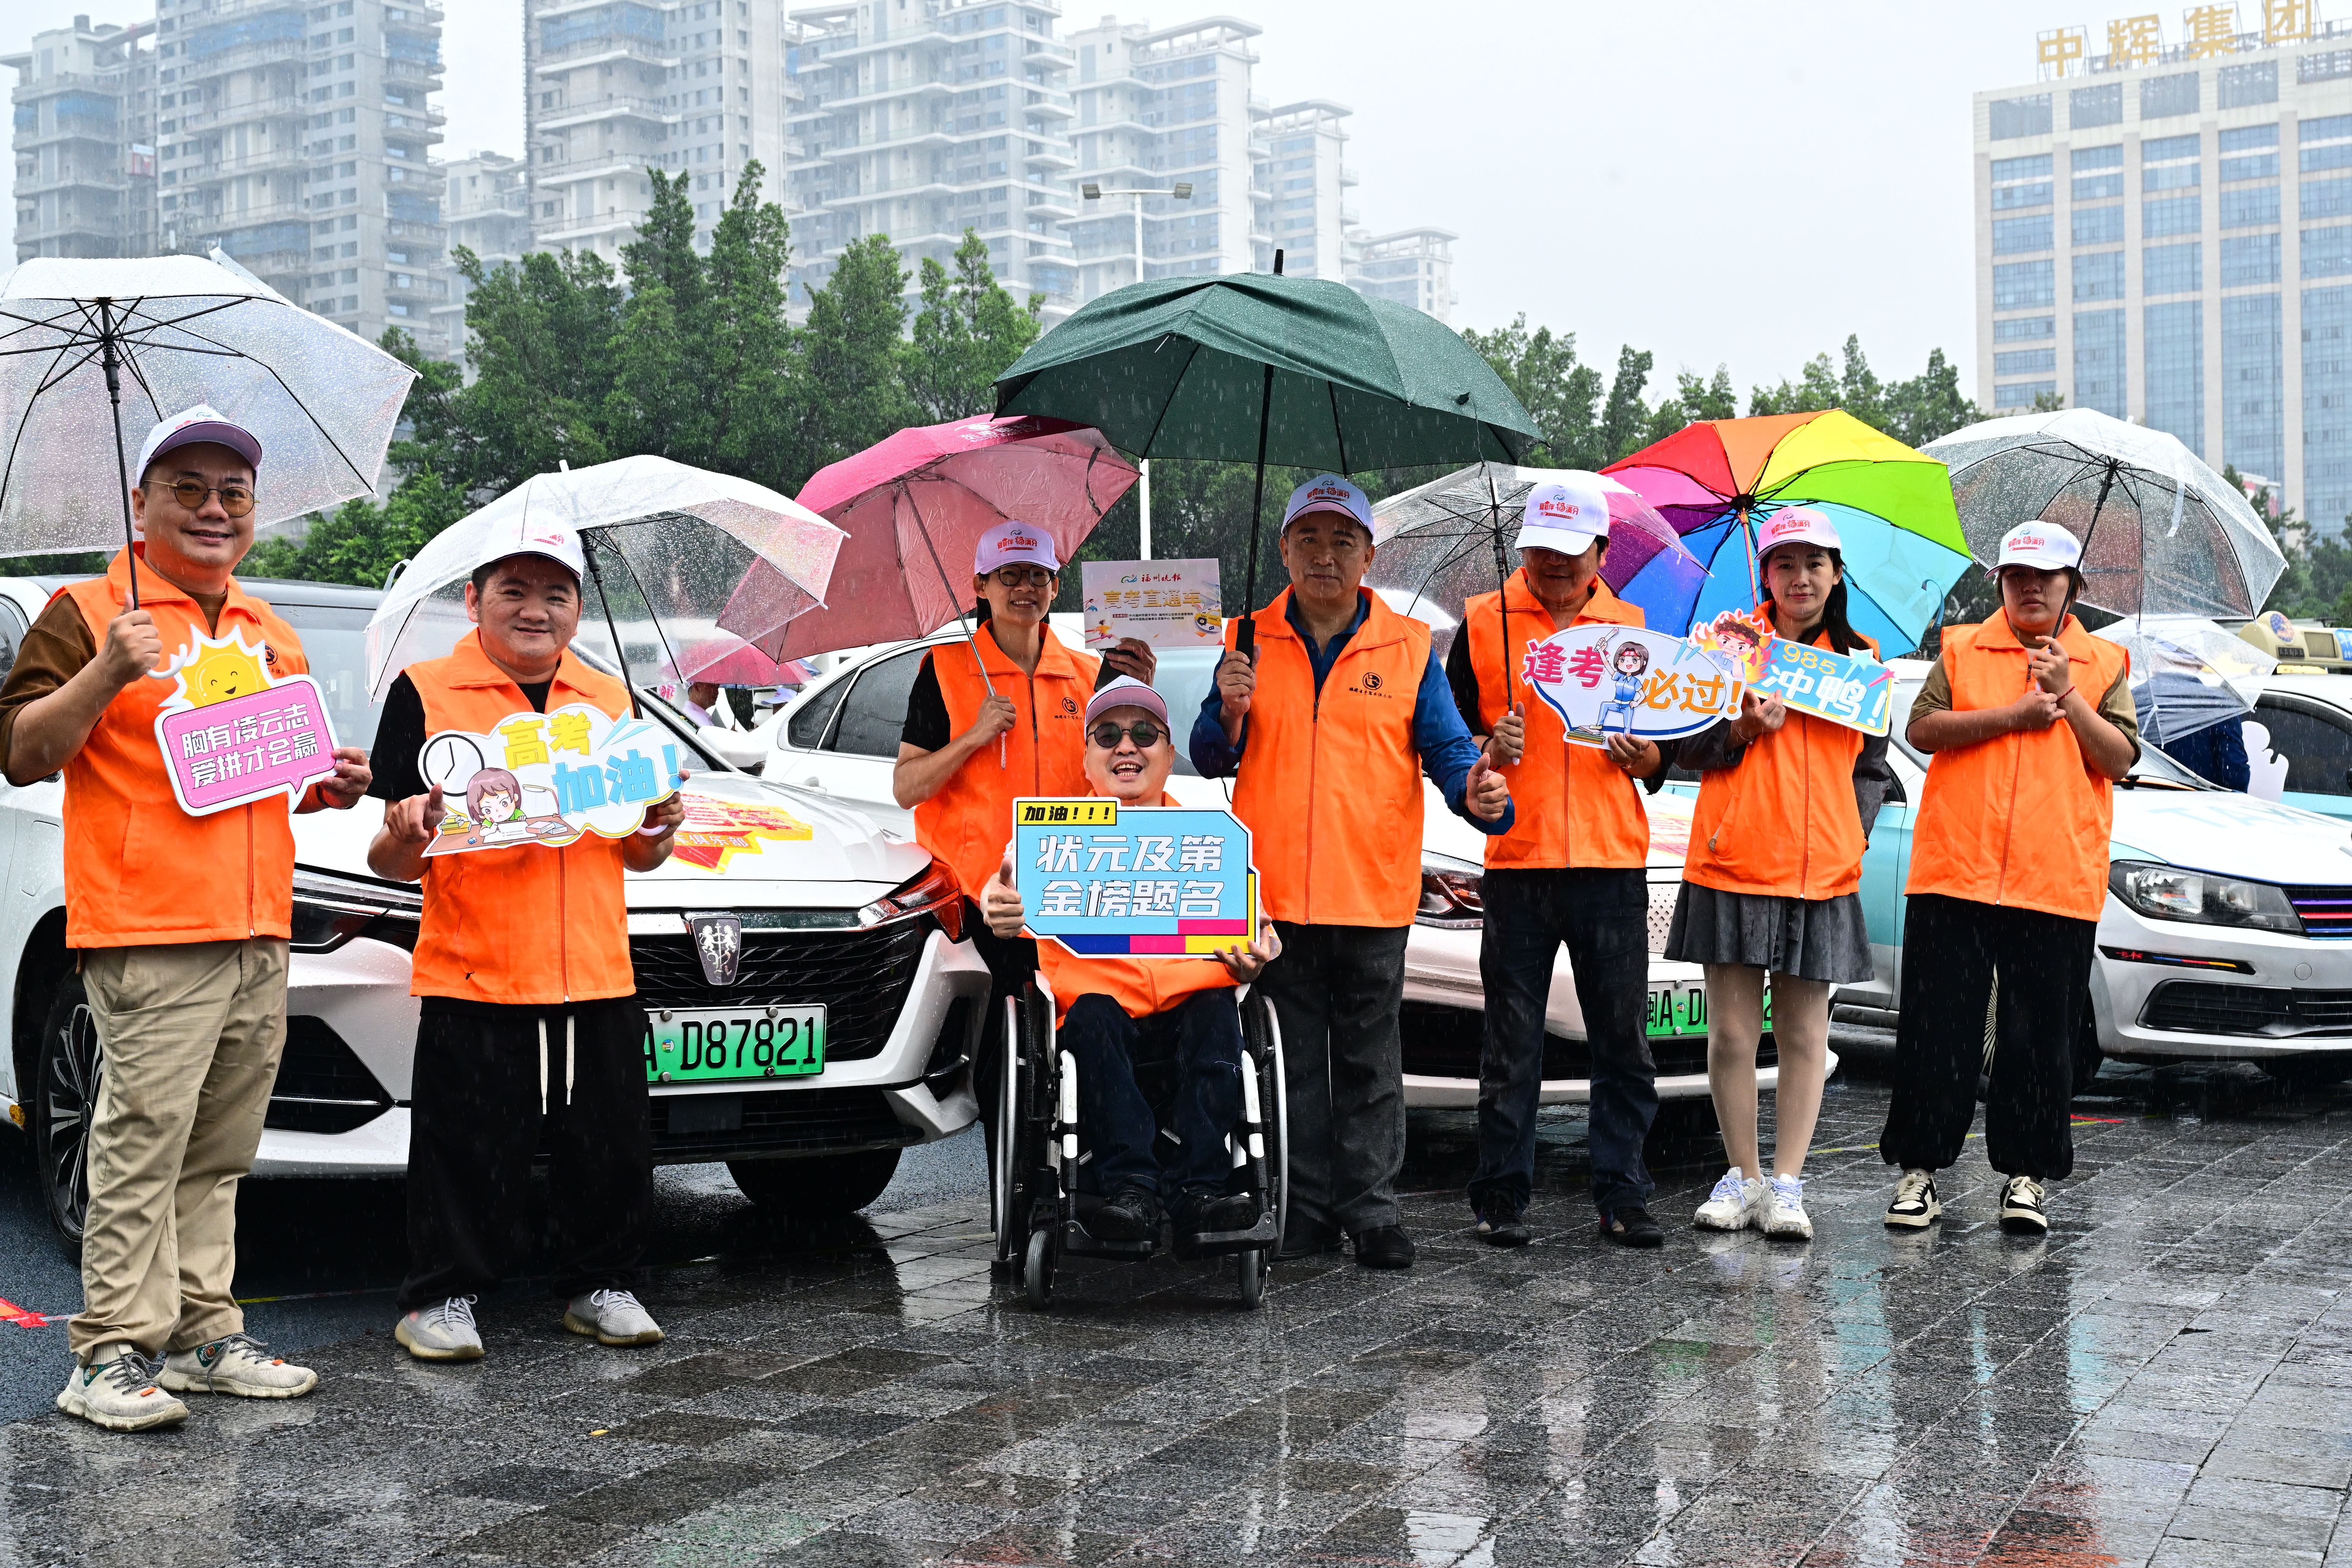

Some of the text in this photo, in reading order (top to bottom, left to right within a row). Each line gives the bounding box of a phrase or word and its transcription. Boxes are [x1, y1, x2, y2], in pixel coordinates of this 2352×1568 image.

[2039, 0, 2312, 77] 中辉集团
[1103, 589, 1201, 609] 高考直通车
[1523, 641, 1609, 689] 逢考
[1783, 643, 1837, 675] 985
[1761, 665, 1888, 727] 冲鸭！
[180, 703, 310, 759] 胸有凌云志
[498, 711, 592, 771] 高考
[191, 730, 319, 789] 爱拼才会赢
[552, 743, 683, 817] 加油！
[1035, 835, 1225, 872] 状元及第
[1035, 880, 1224, 917] 金榜题名
